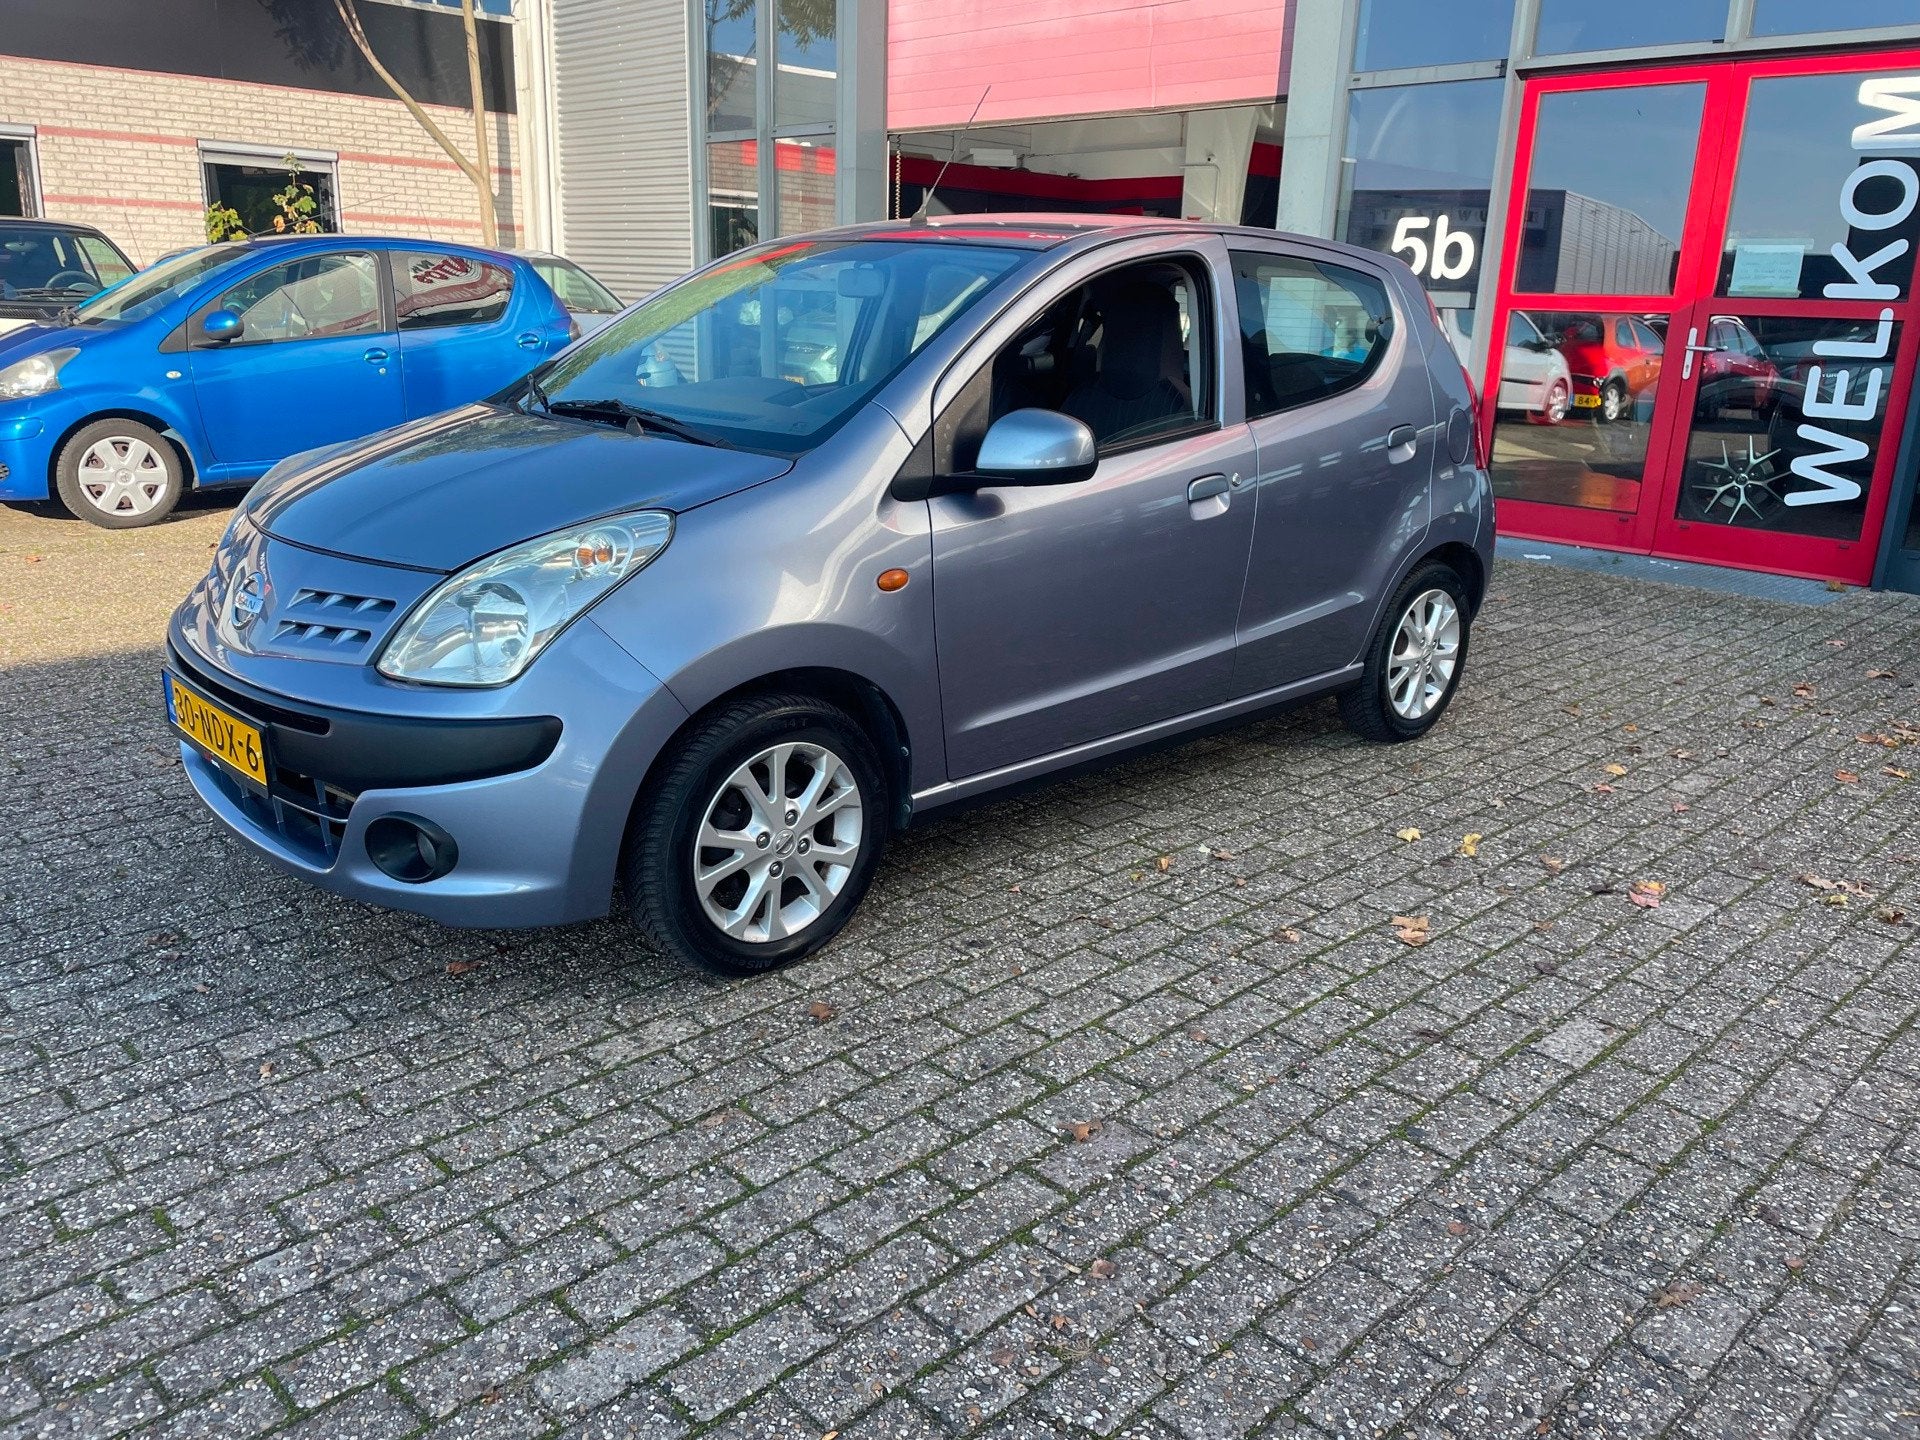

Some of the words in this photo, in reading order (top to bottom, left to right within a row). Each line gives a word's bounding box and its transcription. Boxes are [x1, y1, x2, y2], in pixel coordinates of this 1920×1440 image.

[1391, 214, 1475, 280] 5b
[1784, 77, 1920, 507] WELKOM
[174, 687, 259, 772] 30-NDX-6
